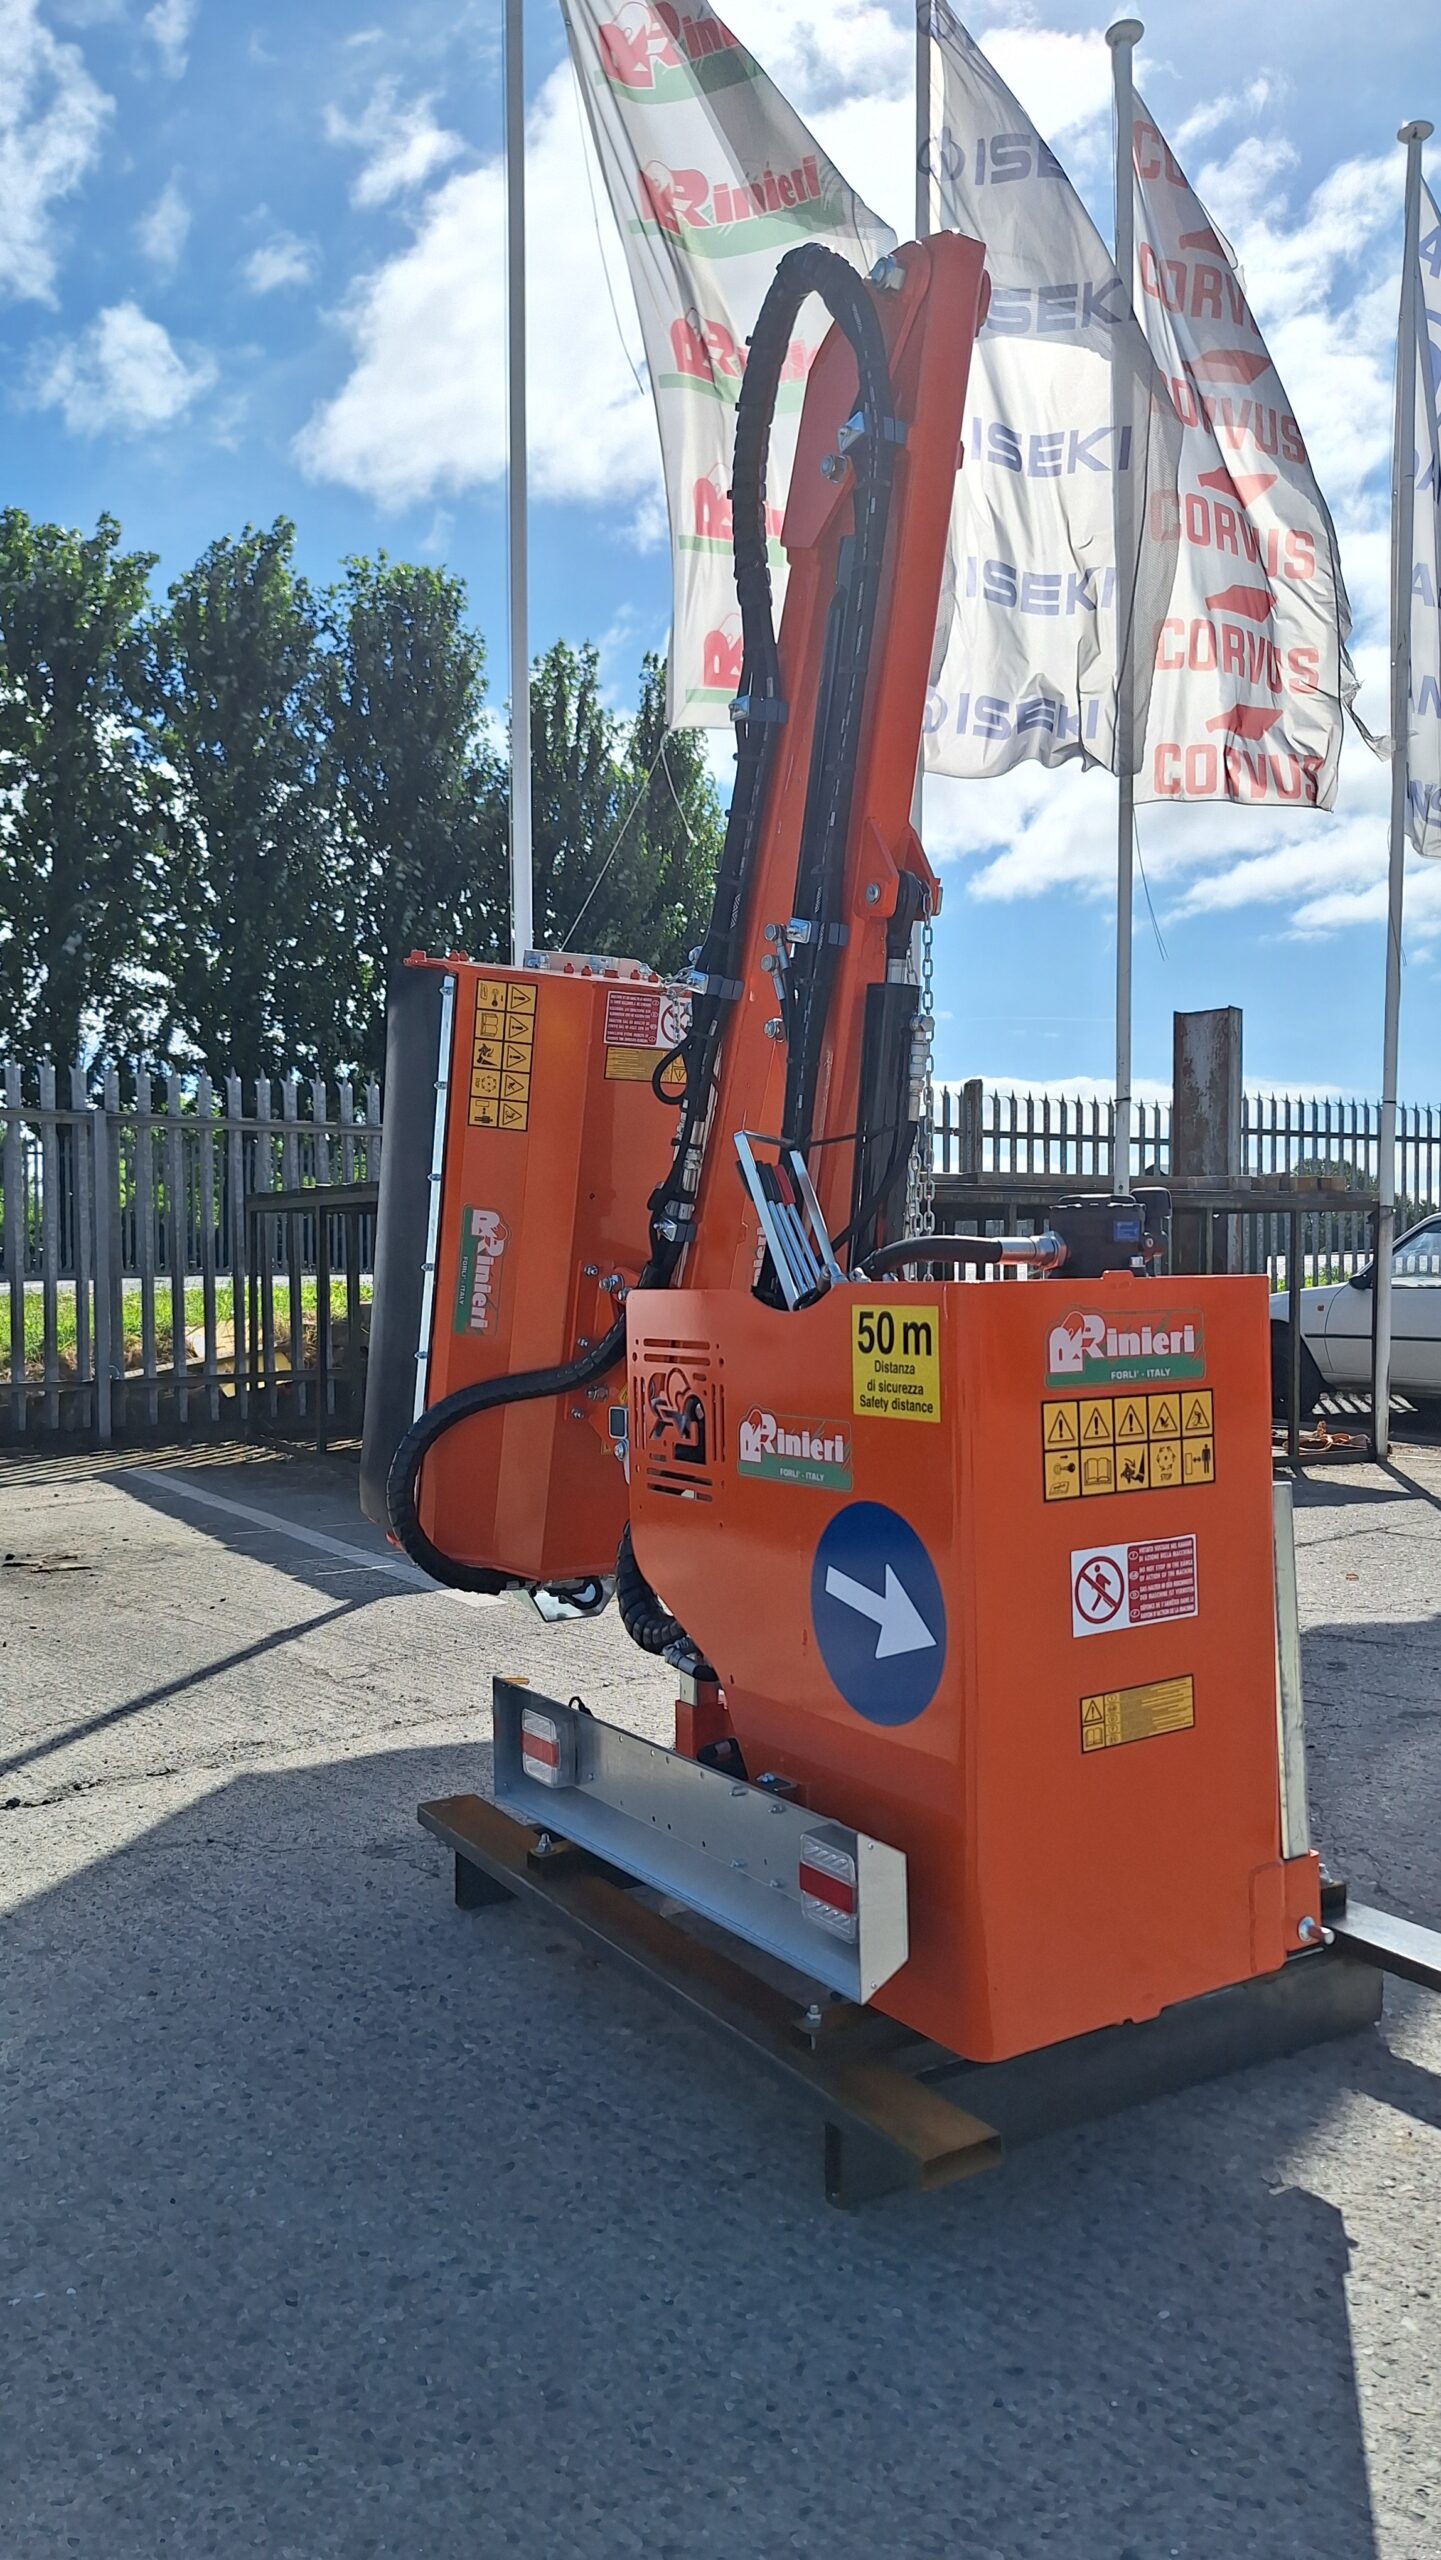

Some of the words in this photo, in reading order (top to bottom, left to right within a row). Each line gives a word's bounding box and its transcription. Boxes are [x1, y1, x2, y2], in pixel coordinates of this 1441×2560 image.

[638, 155, 820, 235] Rinieri
[986, 277, 1139, 335] SEK
[971, 417, 1132, 478] ISEKI
[1151, 489, 1317, 581] CORVUS
[966, 556, 1117, 616] ISEKI
[1154, 617, 1320, 695] CORVUS
[956, 692, 1099, 741] ISEKI
[1154, 742, 1325, 801] CORVUS
[857, 1310, 895, 1355] 50
[903, 1320, 932, 1356] m
[1050, 1312, 1195, 1373] Rinieri
[866, 1379, 876, 1391] di
[878, 1380, 924, 1395] sicurezza
[874, 1359, 916, 1375] Distanza
[1146, 1368, 1171, 1378] ITALY
[859, 1394, 889, 1412] Safety
[891, 1398, 933, 1413] distance
[740, 1410, 844, 1464] Rinieri
[806, 1471, 825, 1482] ITALY
